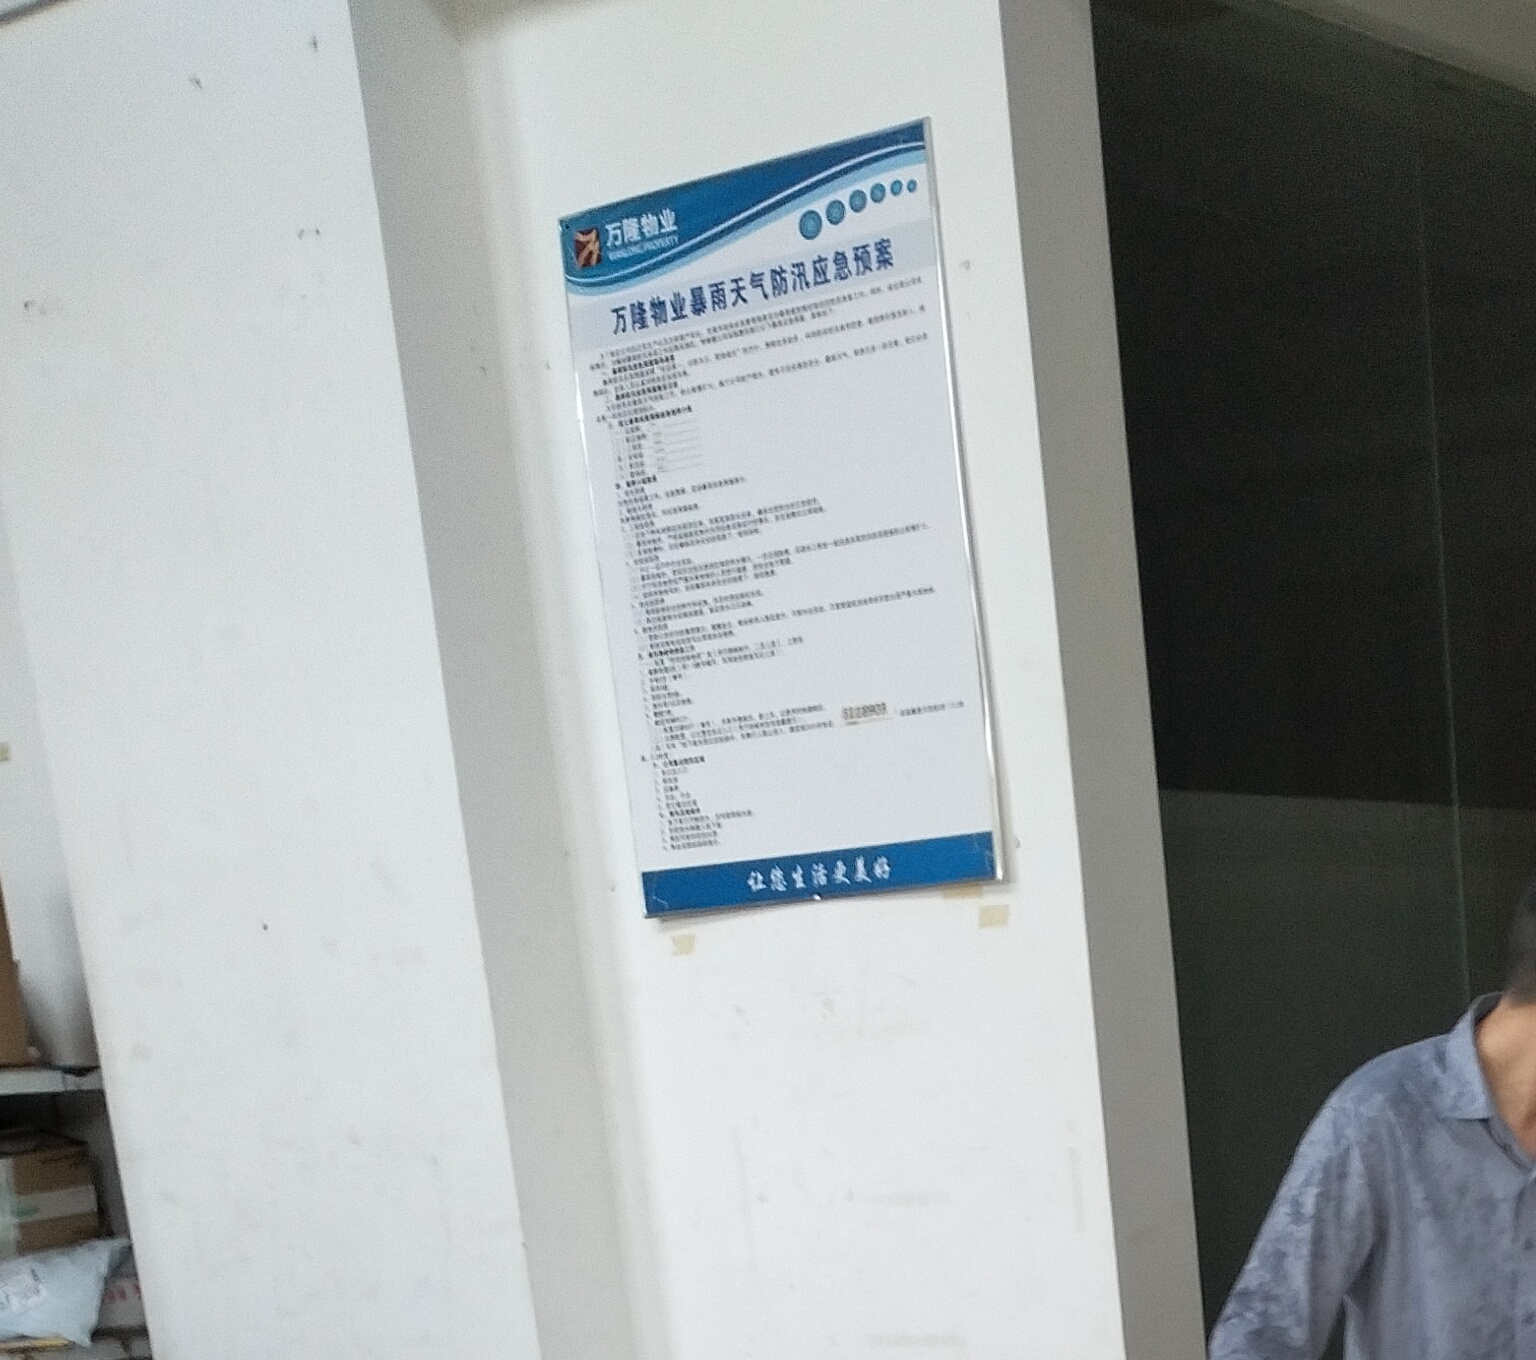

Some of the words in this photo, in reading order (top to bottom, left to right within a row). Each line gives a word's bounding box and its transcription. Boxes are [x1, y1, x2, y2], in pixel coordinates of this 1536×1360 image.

[605, 208, 678, 247] 万隆物业
[611, 238, 893, 334] 万隆物业暴雨天气防汛应急预案
[747, 855, 891, 892] 让您生活更美好
